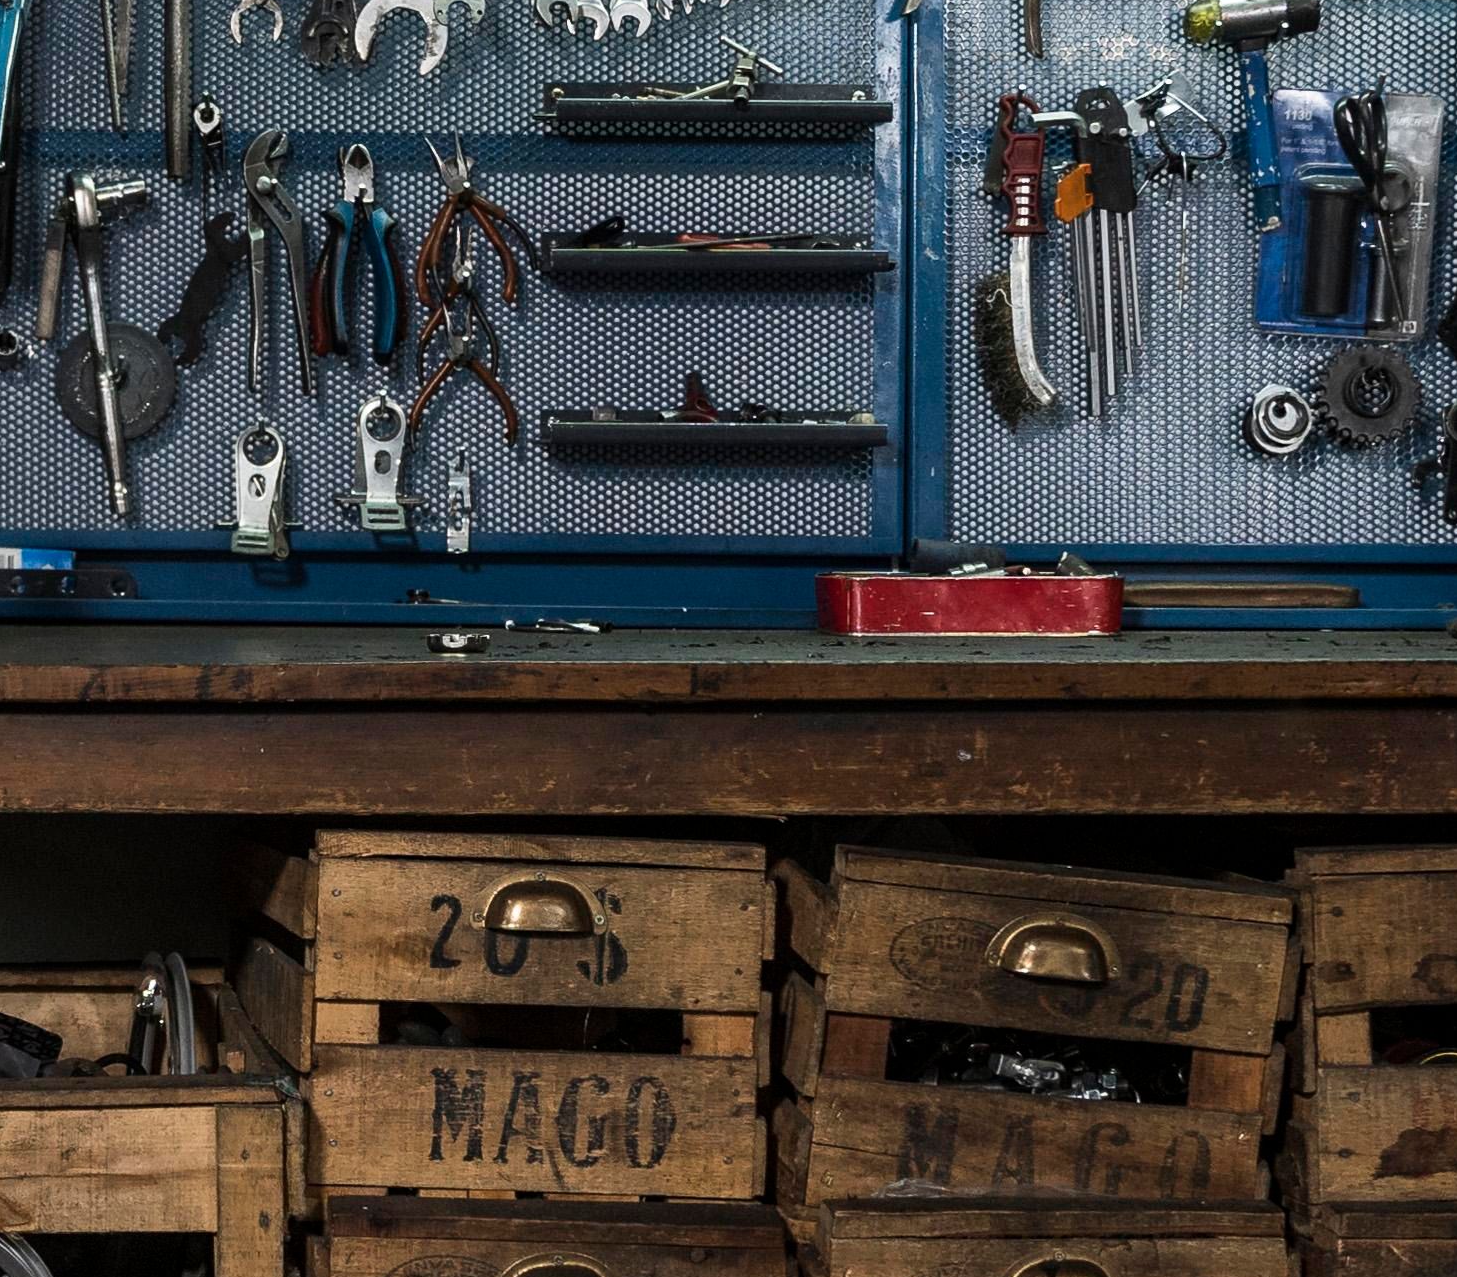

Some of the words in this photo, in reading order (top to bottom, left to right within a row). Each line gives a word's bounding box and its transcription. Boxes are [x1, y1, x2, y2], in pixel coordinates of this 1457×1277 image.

[1117, 953, 1211, 1033] 20
[428, 1067, 678, 1170] MAGO
[896, 1103, 1212, 1198] MAGO
